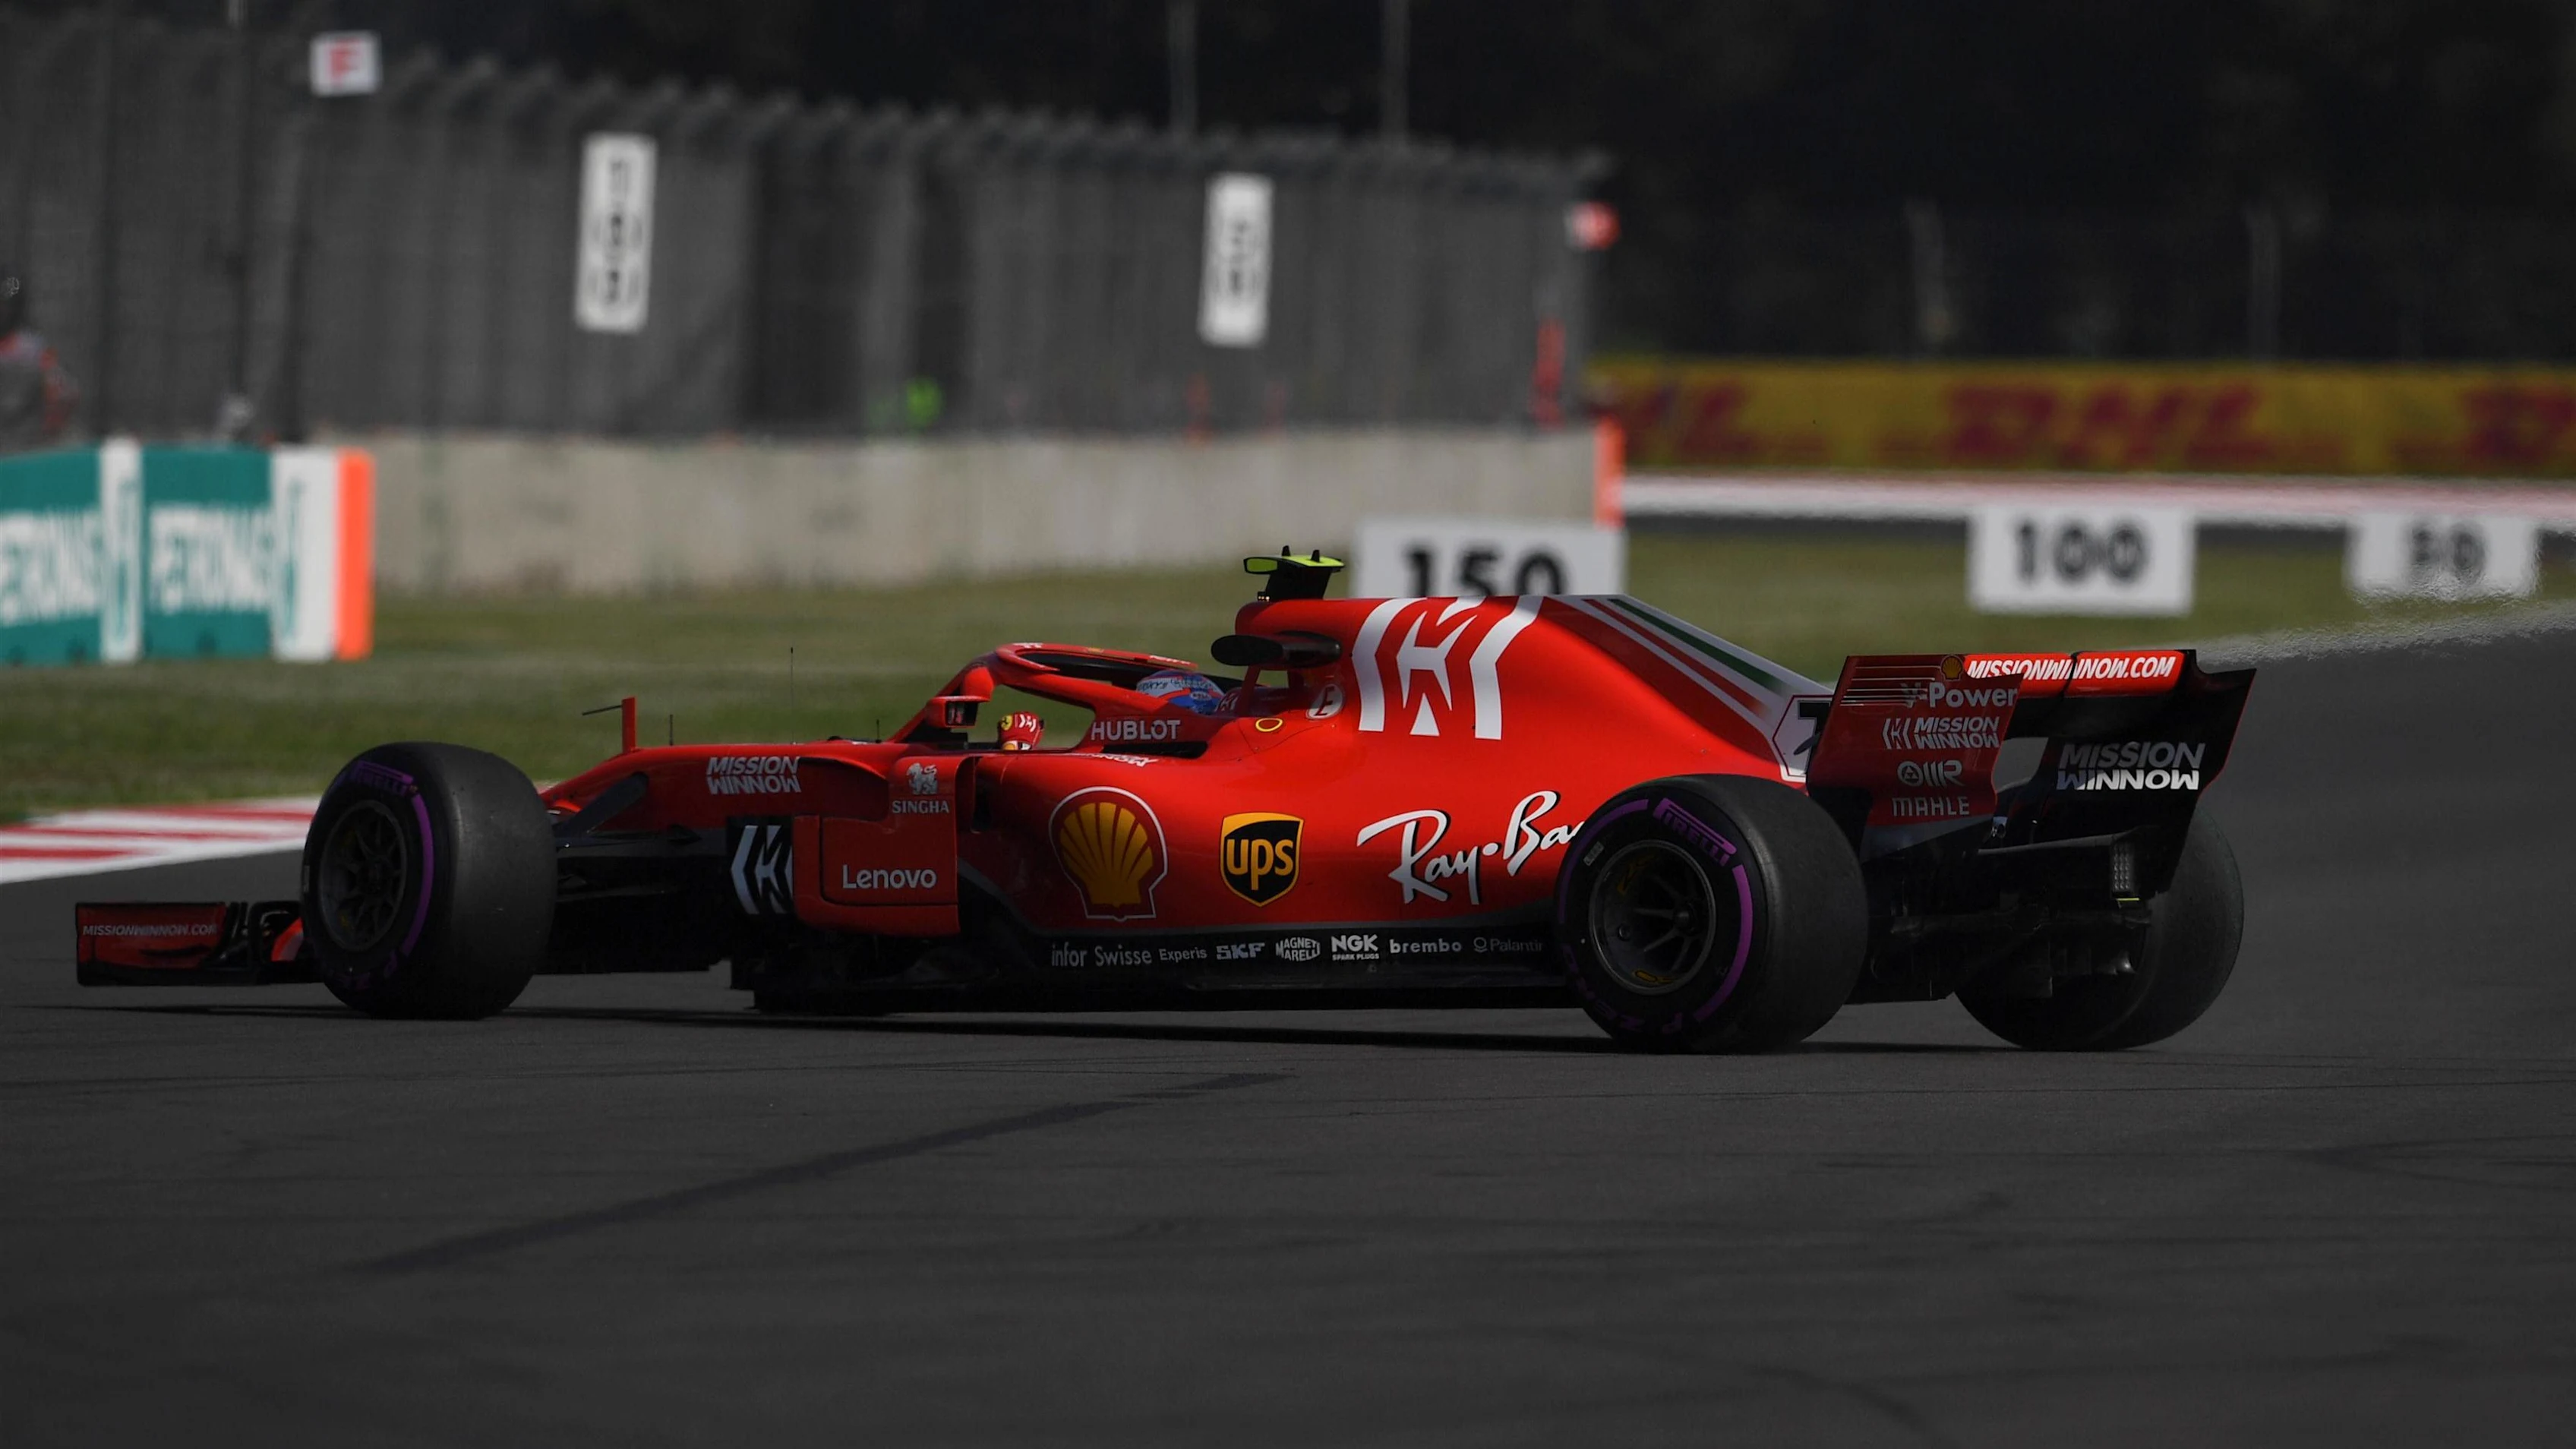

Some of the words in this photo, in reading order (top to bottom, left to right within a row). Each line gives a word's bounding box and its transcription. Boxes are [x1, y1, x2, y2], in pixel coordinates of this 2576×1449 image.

[2016, 519, 2152, 585] 100
[1406, 545, 1568, 598] 150
[1967, 656, 2177, 680] MISSIONWINNOW.COM
[1091, 720, 1180, 740] HUBLOT
[1914, 716, 2000, 733] MISSION
[1915, 733, 2000, 750] WINNOW
[2059, 741, 2206, 769] MISSION
[706, 756, 800, 775] MISSION
[706, 775, 801, 794] WINNOW
[2057, 769, 2200, 791] WINNOW
[892, 800, 950, 814] SINGHA
[1893, 797, 1969, 816] MAHLE
[1653, 797, 1737, 867] PIRELLI
[1226, 838, 1294, 891] ups
[842, 864, 936, 889] Lenovo
[1216, 942, 1266, 960] SKF
[1331, 934, 1379, 952] NGK
[1389, 939, 1463, 954] brembo
[1051, 942, 1087, 967] infor
[1094, 945, 1153, 967] Swisse
[1159, 946, 1208, 963] Experis
